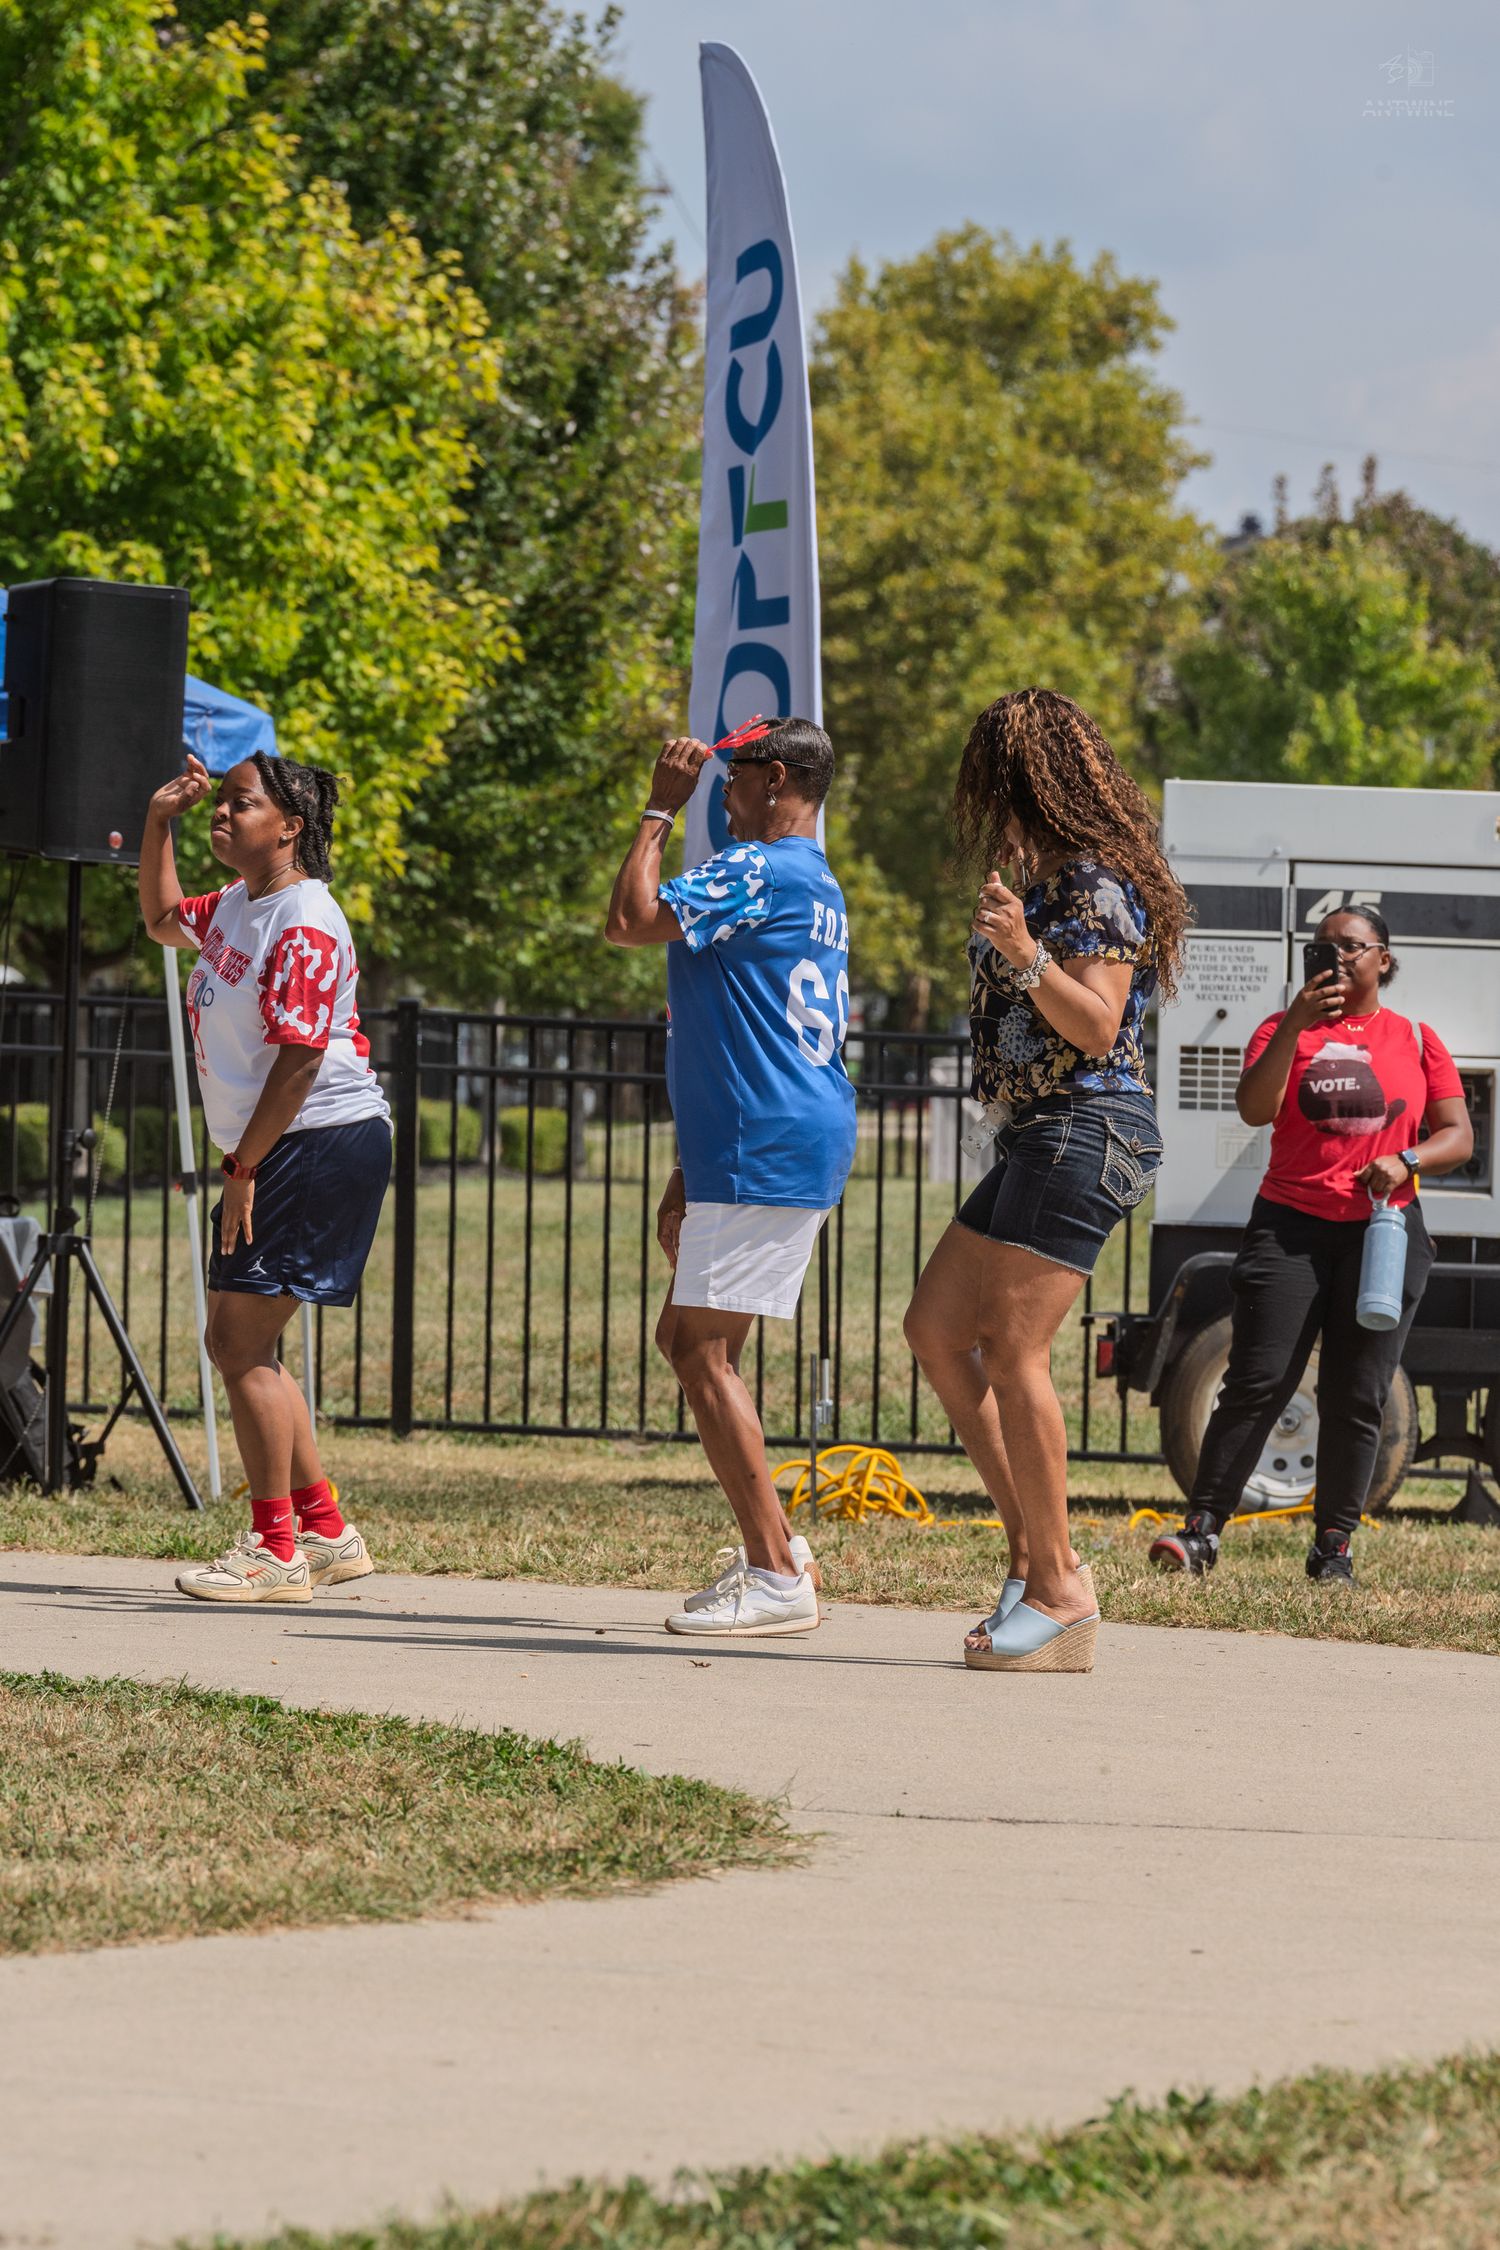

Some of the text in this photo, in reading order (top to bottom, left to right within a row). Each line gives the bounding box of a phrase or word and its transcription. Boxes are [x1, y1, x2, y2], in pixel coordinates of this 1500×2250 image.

[1190, 945, 1254, 953] PURCHASED
[1222, 955, 1255, 963] FUNDS
[1250, 965, 1268, 973] THE
[1199, 974, 1267, 983] DEPARTMENT
[1183, 983, 1261, 992] OF HOMELAND
[1196, 994, 1246, 1002] SECURITY
[1309, 1077, 1361, 1094] VOTE.
